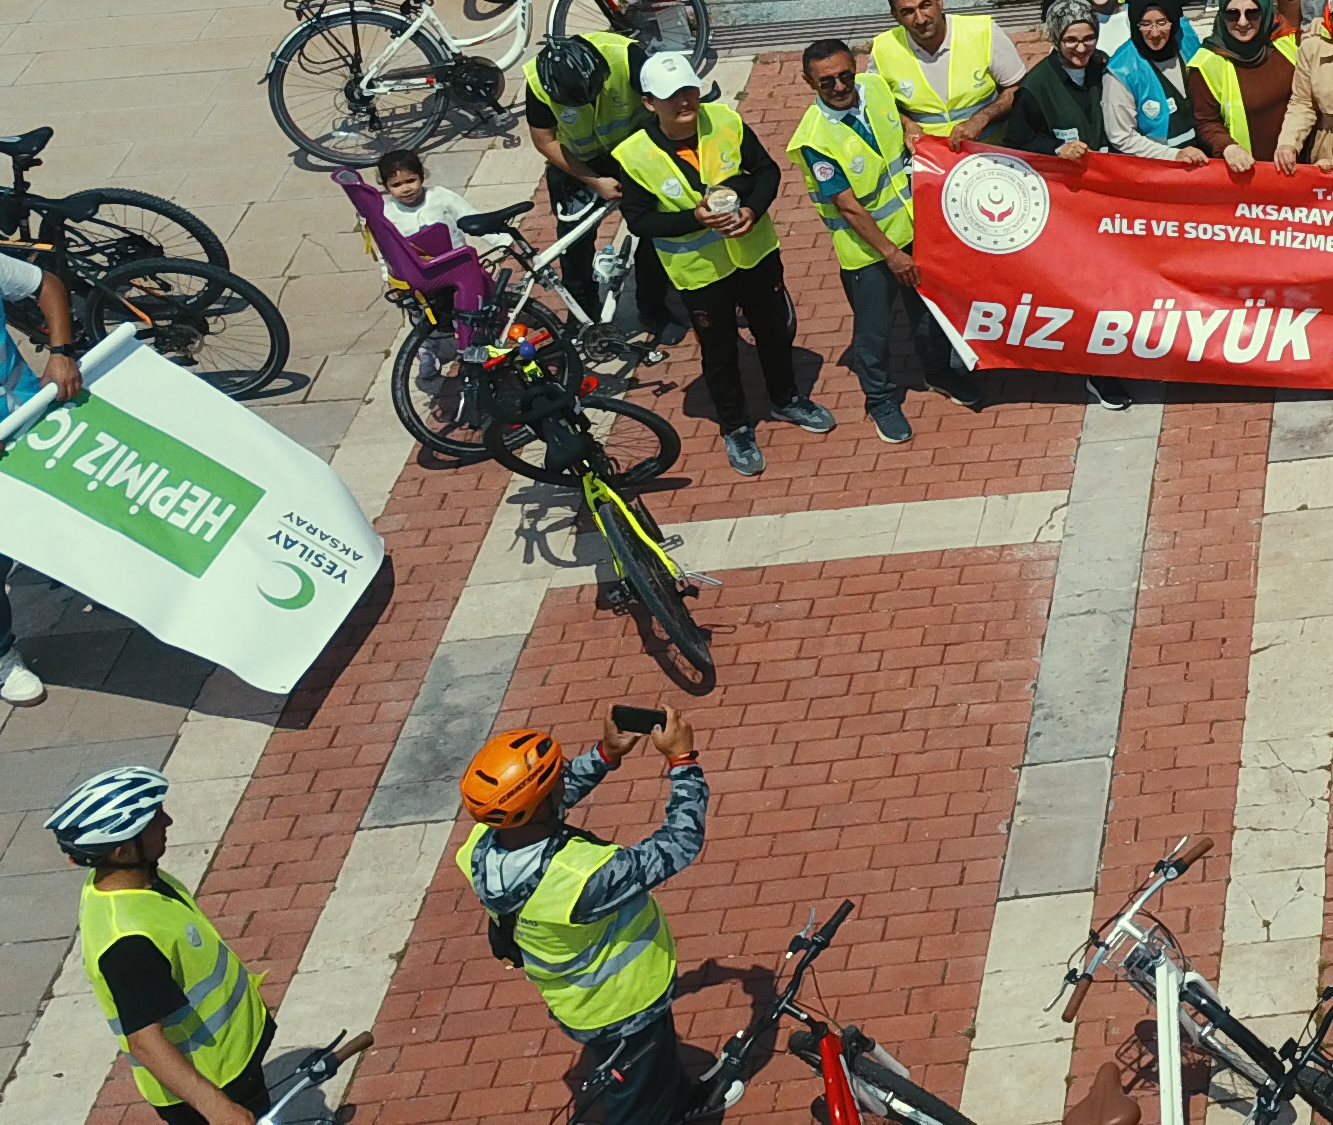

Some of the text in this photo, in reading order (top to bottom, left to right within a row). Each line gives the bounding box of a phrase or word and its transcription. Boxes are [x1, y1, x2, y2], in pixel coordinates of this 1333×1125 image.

[1098, 214, 1147, 236] AİLE
[1151, 220, 1180, 237] VE
[1184, 222, 1267, 245] SOSYAL
[1235, 203, 1333, 227] AKSARAY
[963, 293, 1074, 351] BİZ
[1087, 298, 1322, 364] BÜYÜK
[72, 431, 237, 543] HEPİMİZ
[282, 511, 364, 561] AKSARAY
